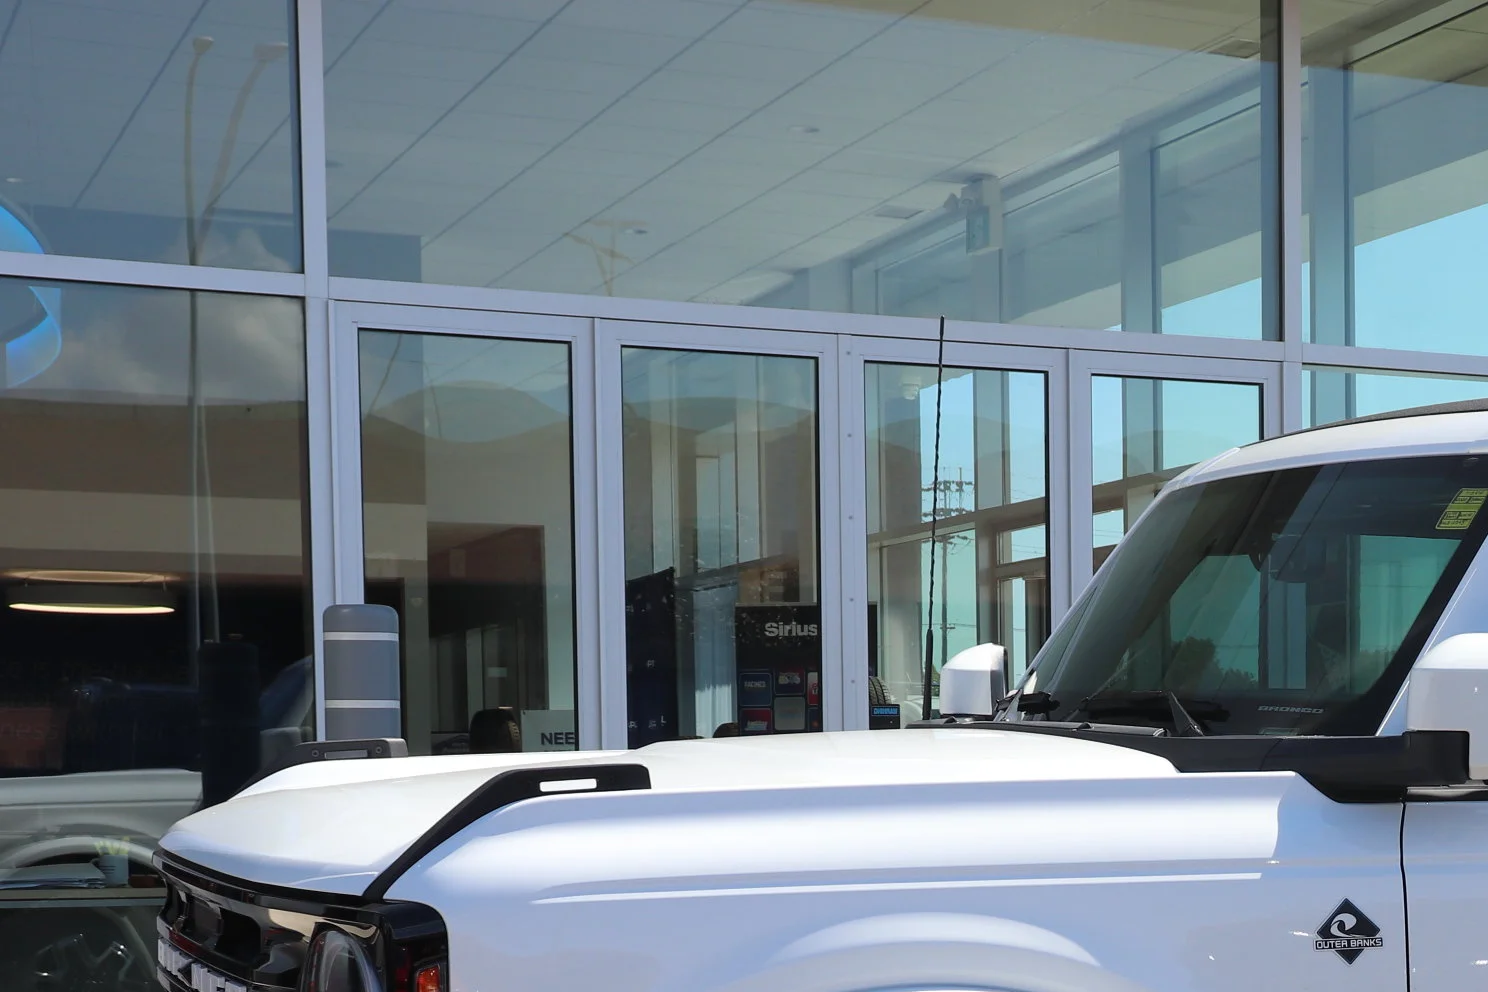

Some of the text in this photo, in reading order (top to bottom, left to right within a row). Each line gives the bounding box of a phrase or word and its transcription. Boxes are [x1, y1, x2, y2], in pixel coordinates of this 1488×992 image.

[764, 621, 818, 637] Sirius
[1316, 938, 1383, 949] OUTER BANKS
